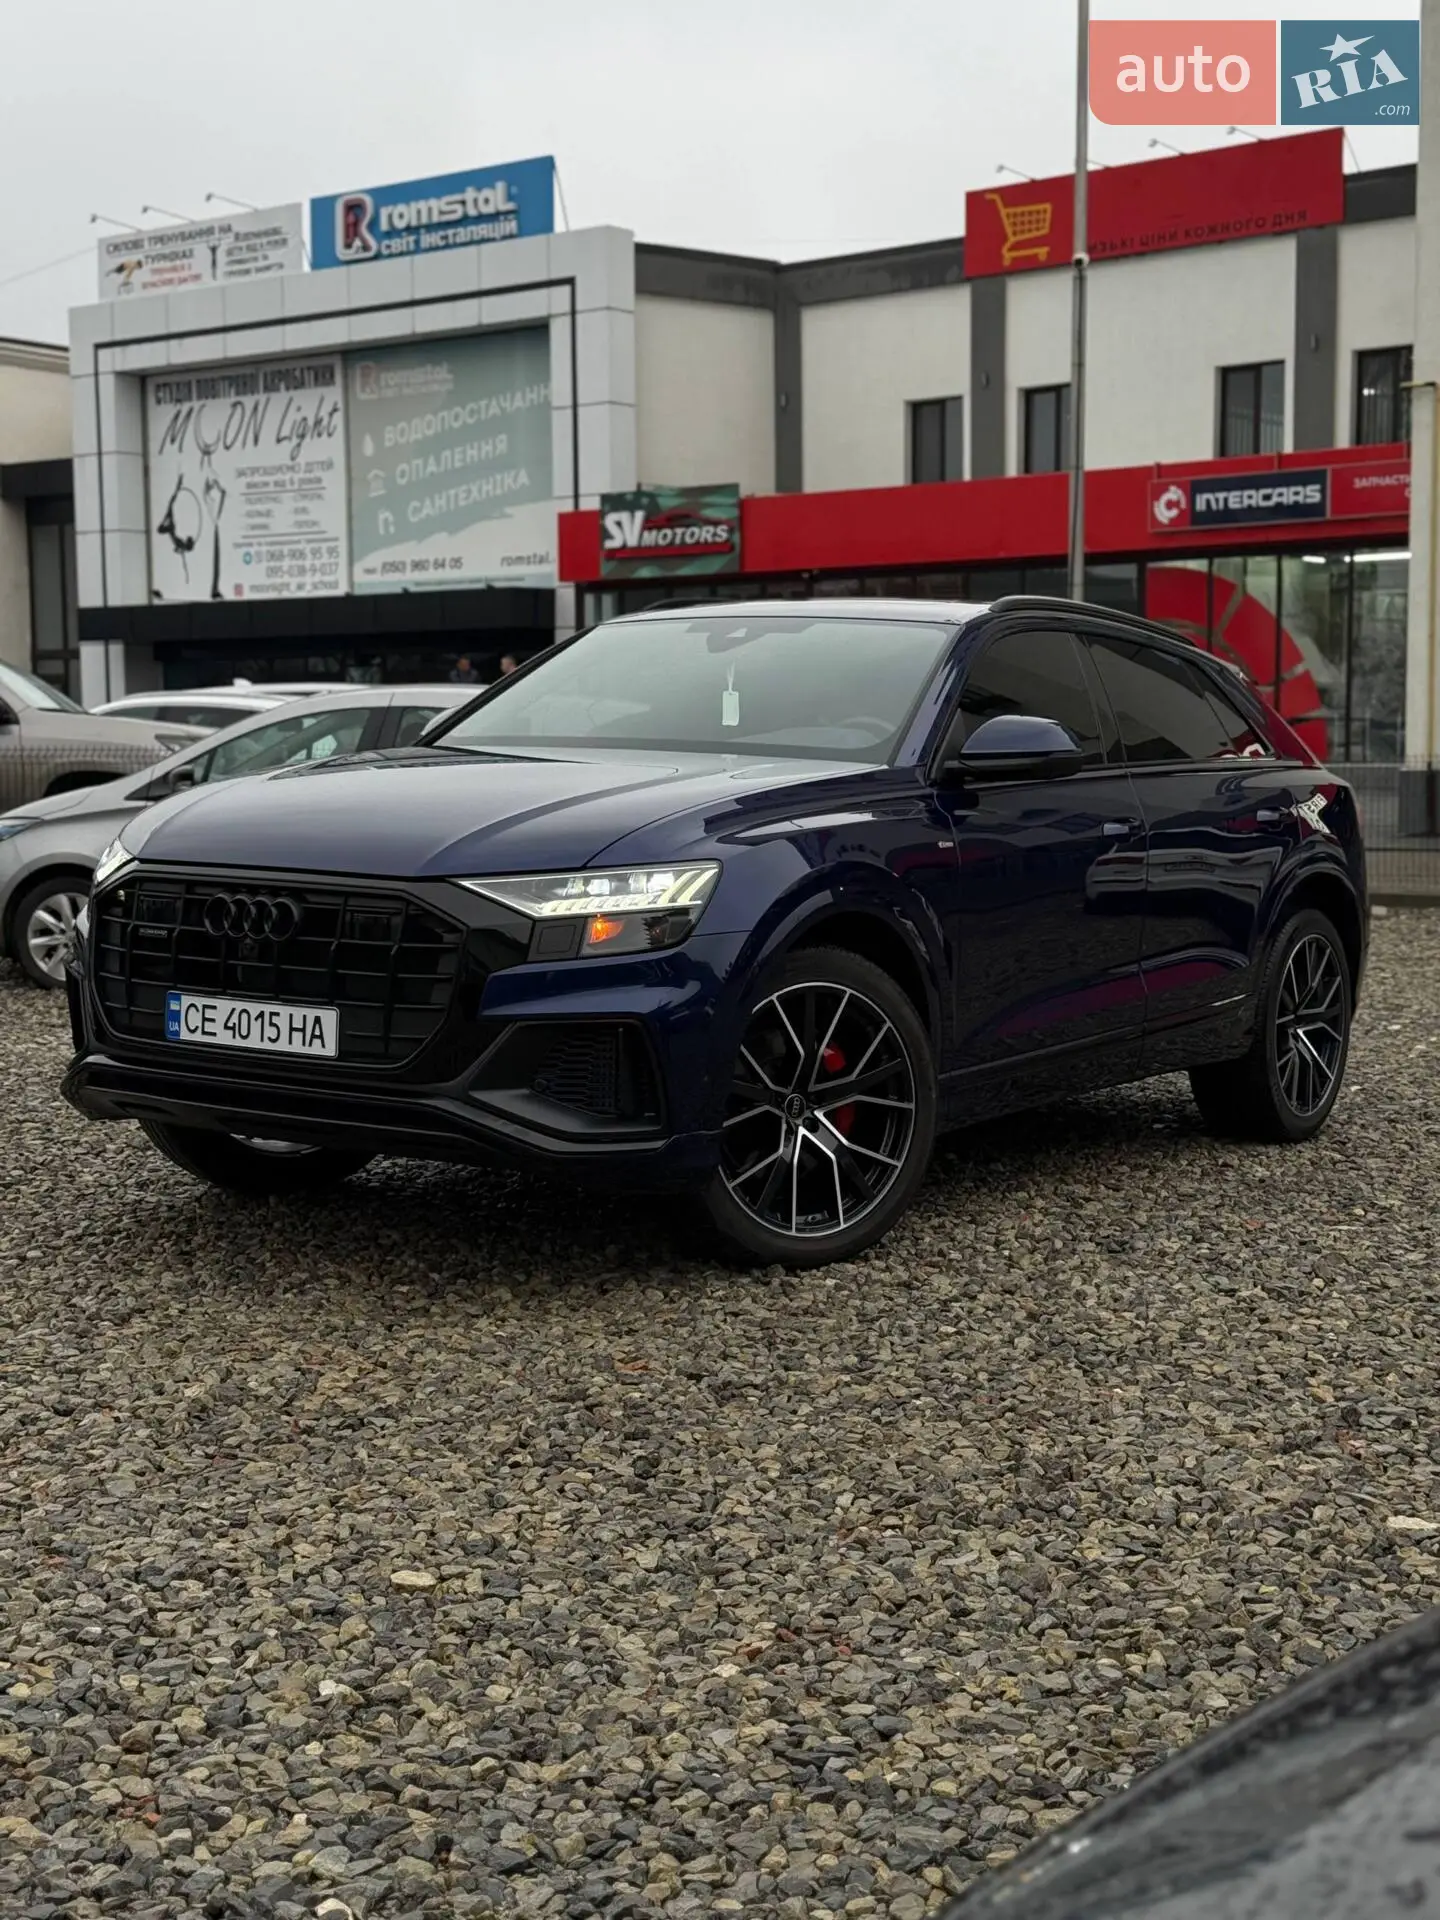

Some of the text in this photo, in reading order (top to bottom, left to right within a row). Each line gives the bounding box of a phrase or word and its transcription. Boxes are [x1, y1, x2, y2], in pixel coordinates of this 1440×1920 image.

[379, 181, 517, 233] romstal
[380, 216, 518, 256] світ інсталяцій
[1085, 209, 1308, 253] ИЗЬКІ ЦІНИ КОЖНОГО ДНЯ
[275, 395, 341, 462] Light
[384, 383, 551, 448] ВОДОПОСТАЧАНН
[395, 433, 508, 486] ОПАЛЕННЯ
[407, 467, 530, 523] САНТЕХНІКА
[1195, 484, 1322, 513] INTERCARS
[603, 511, 729, 550] SV MOTORS
[168, 1021, 180, 1032] UA
[184, 1002, 326, 1049] CE 4015 HA
